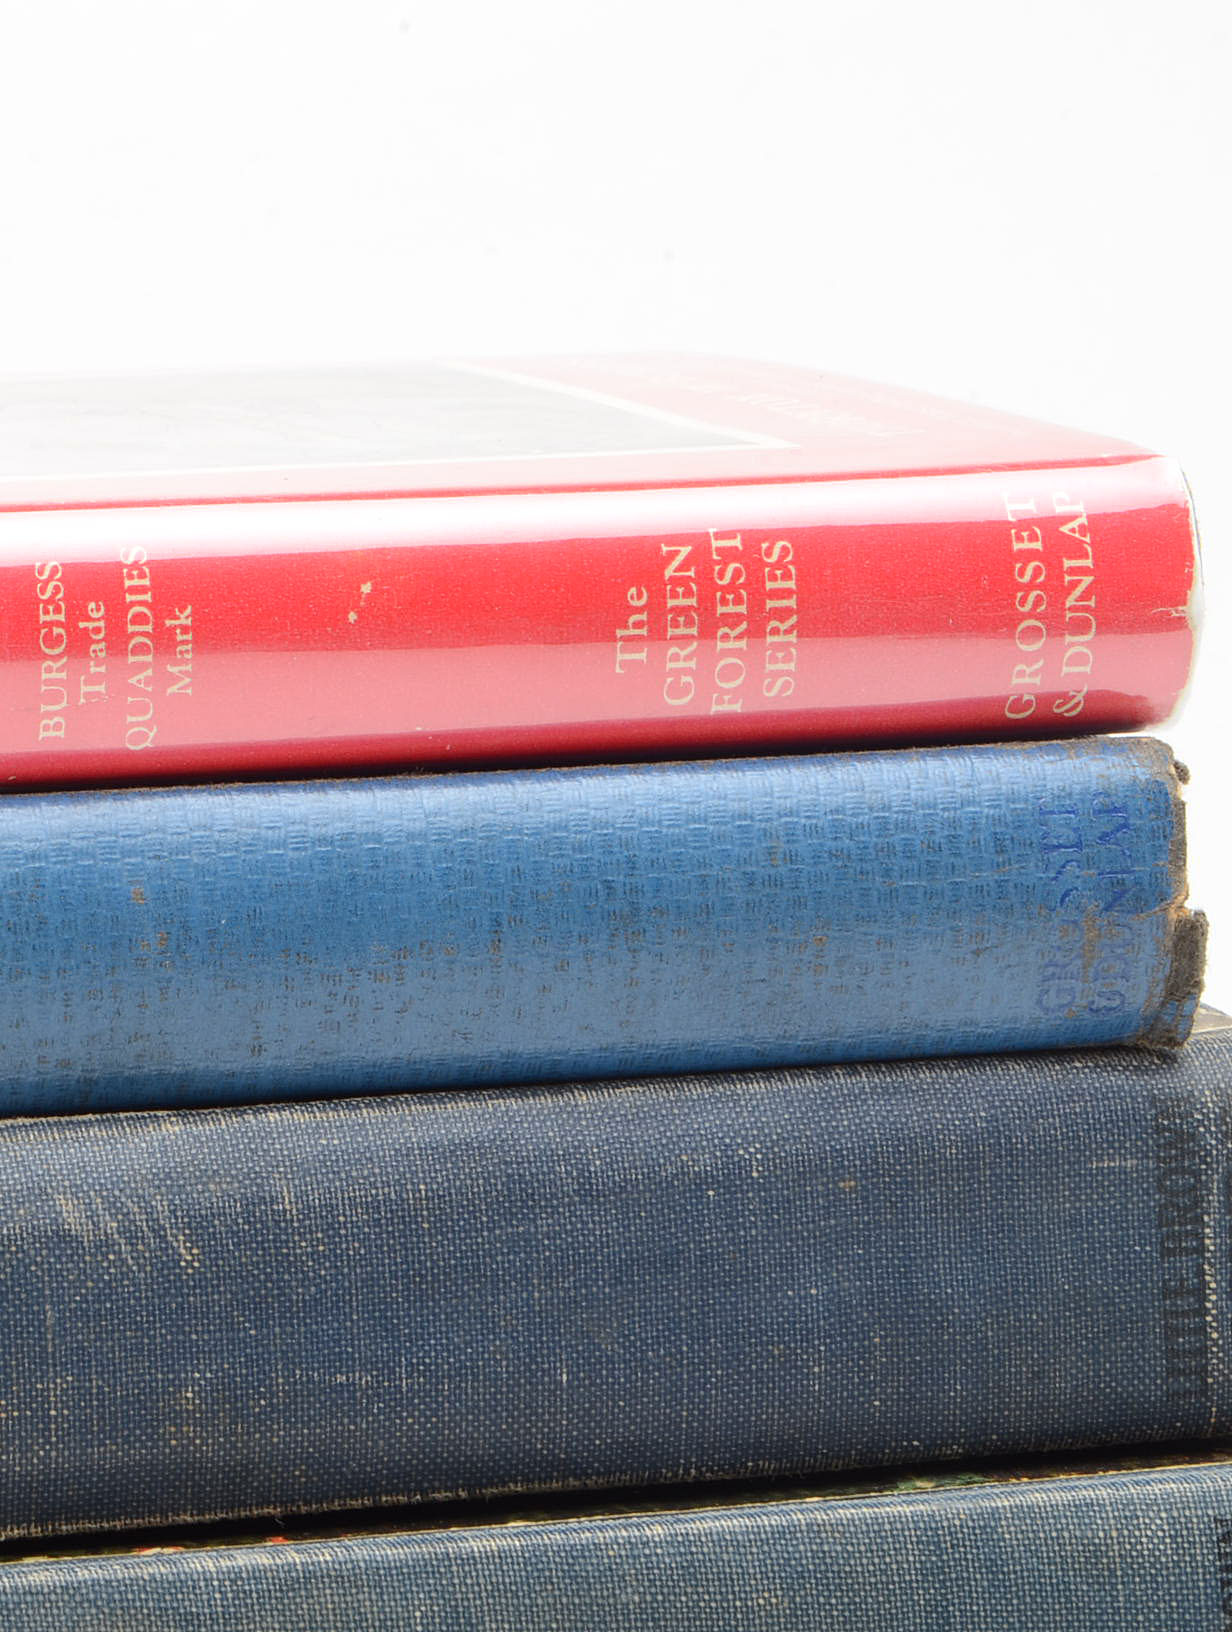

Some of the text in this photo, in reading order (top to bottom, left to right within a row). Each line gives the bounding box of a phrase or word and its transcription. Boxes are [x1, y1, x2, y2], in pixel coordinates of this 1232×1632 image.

[35, 561, 67, 741] BURGESS
[79, 601, 106, 706] Trade
[120, 546, 157, 750] QUADDIES
[165, 605, 192, 696] Mark
[616, 586, 648, 673] The
[661, 543, 698, 706] GREEN
[708, 528, 748, 715] FOREST
[762, 541, 797, 697] SERIES
[1002, 493, 1047, 719] GROSSET
[1053, 491, 1096, 717] & DUNLAP
